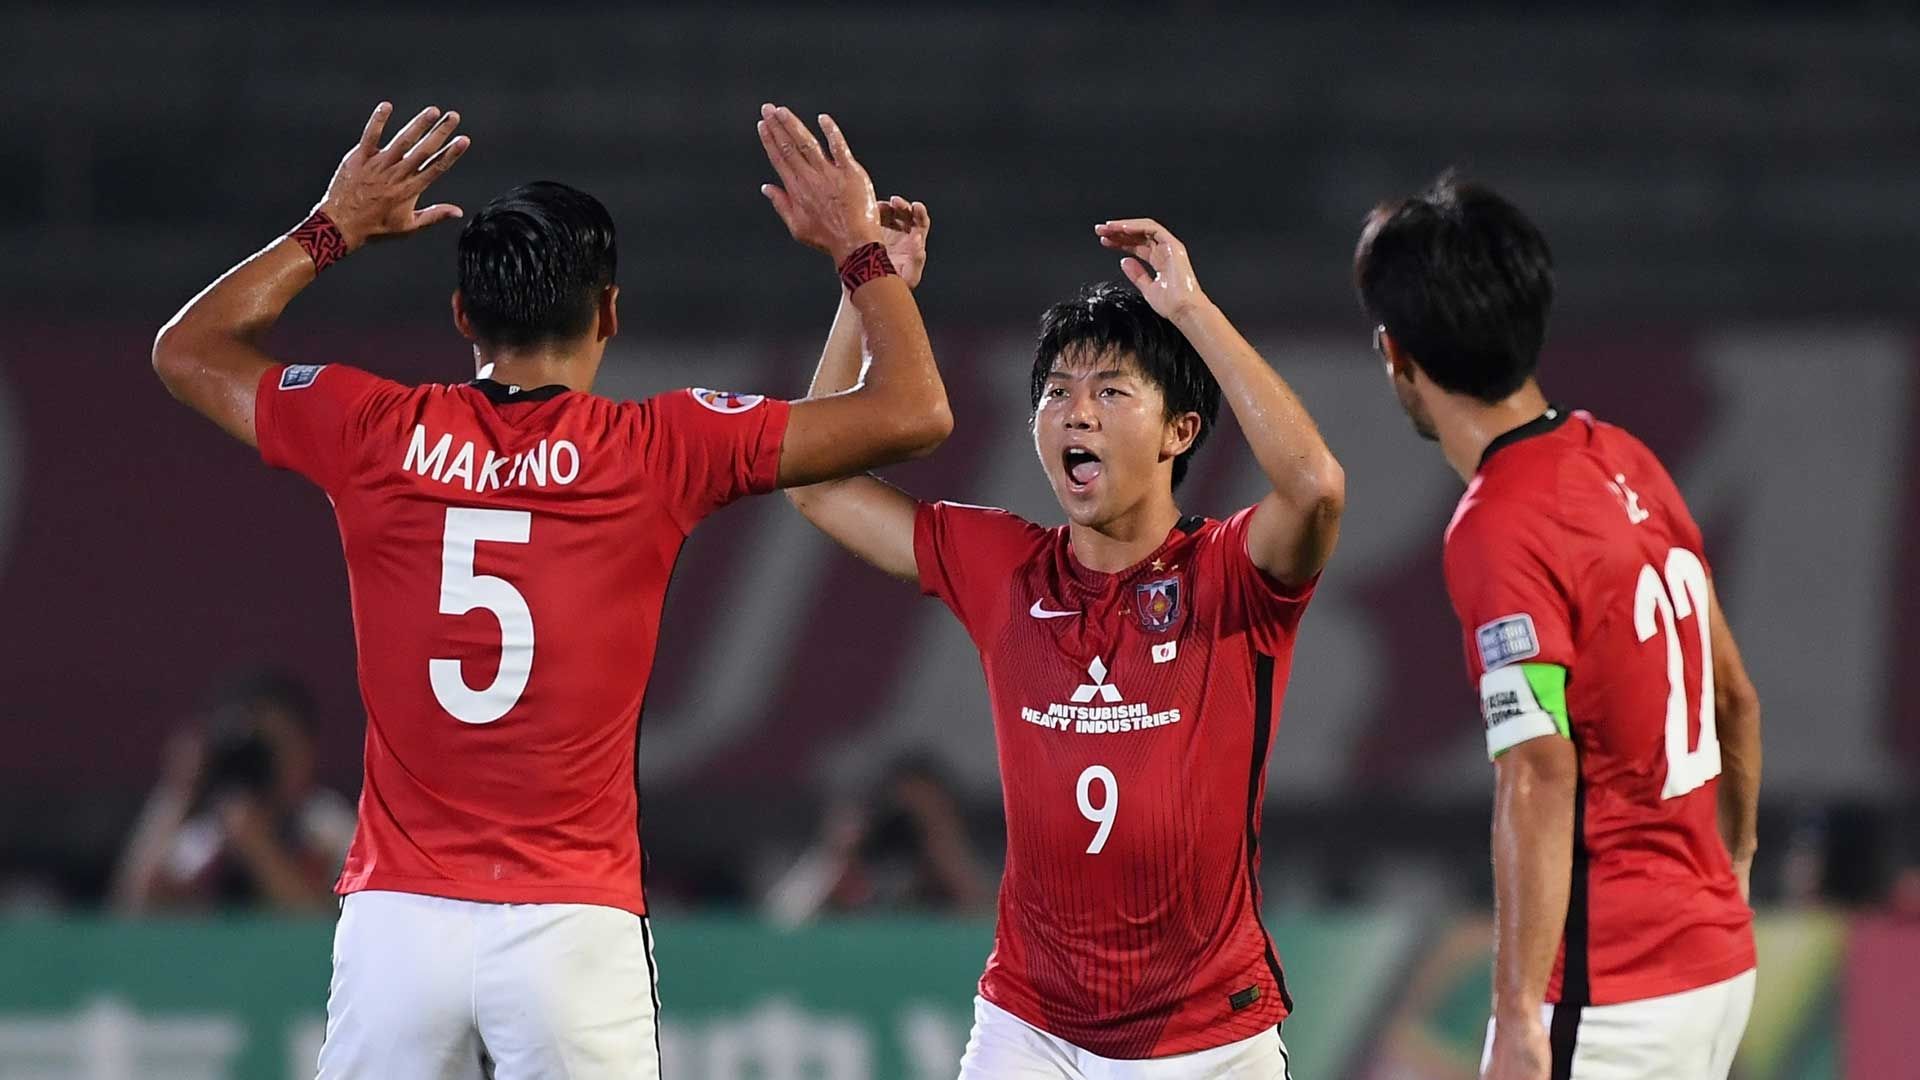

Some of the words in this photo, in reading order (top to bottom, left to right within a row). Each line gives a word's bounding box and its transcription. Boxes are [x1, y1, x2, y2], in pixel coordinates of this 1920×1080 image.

[402, 424, 580, 493] MAKINO
[428, 507, 535, 725] 5
[1048, 703, 1148, 720] MITSUBISHI
[1633, 547, 1722, 801] 22
[1021, 706, 1071, 731] HEAVY
[1075, 709, 1181, 734] INDUSTRIES
[1075, 764, 1119, 854] 9
